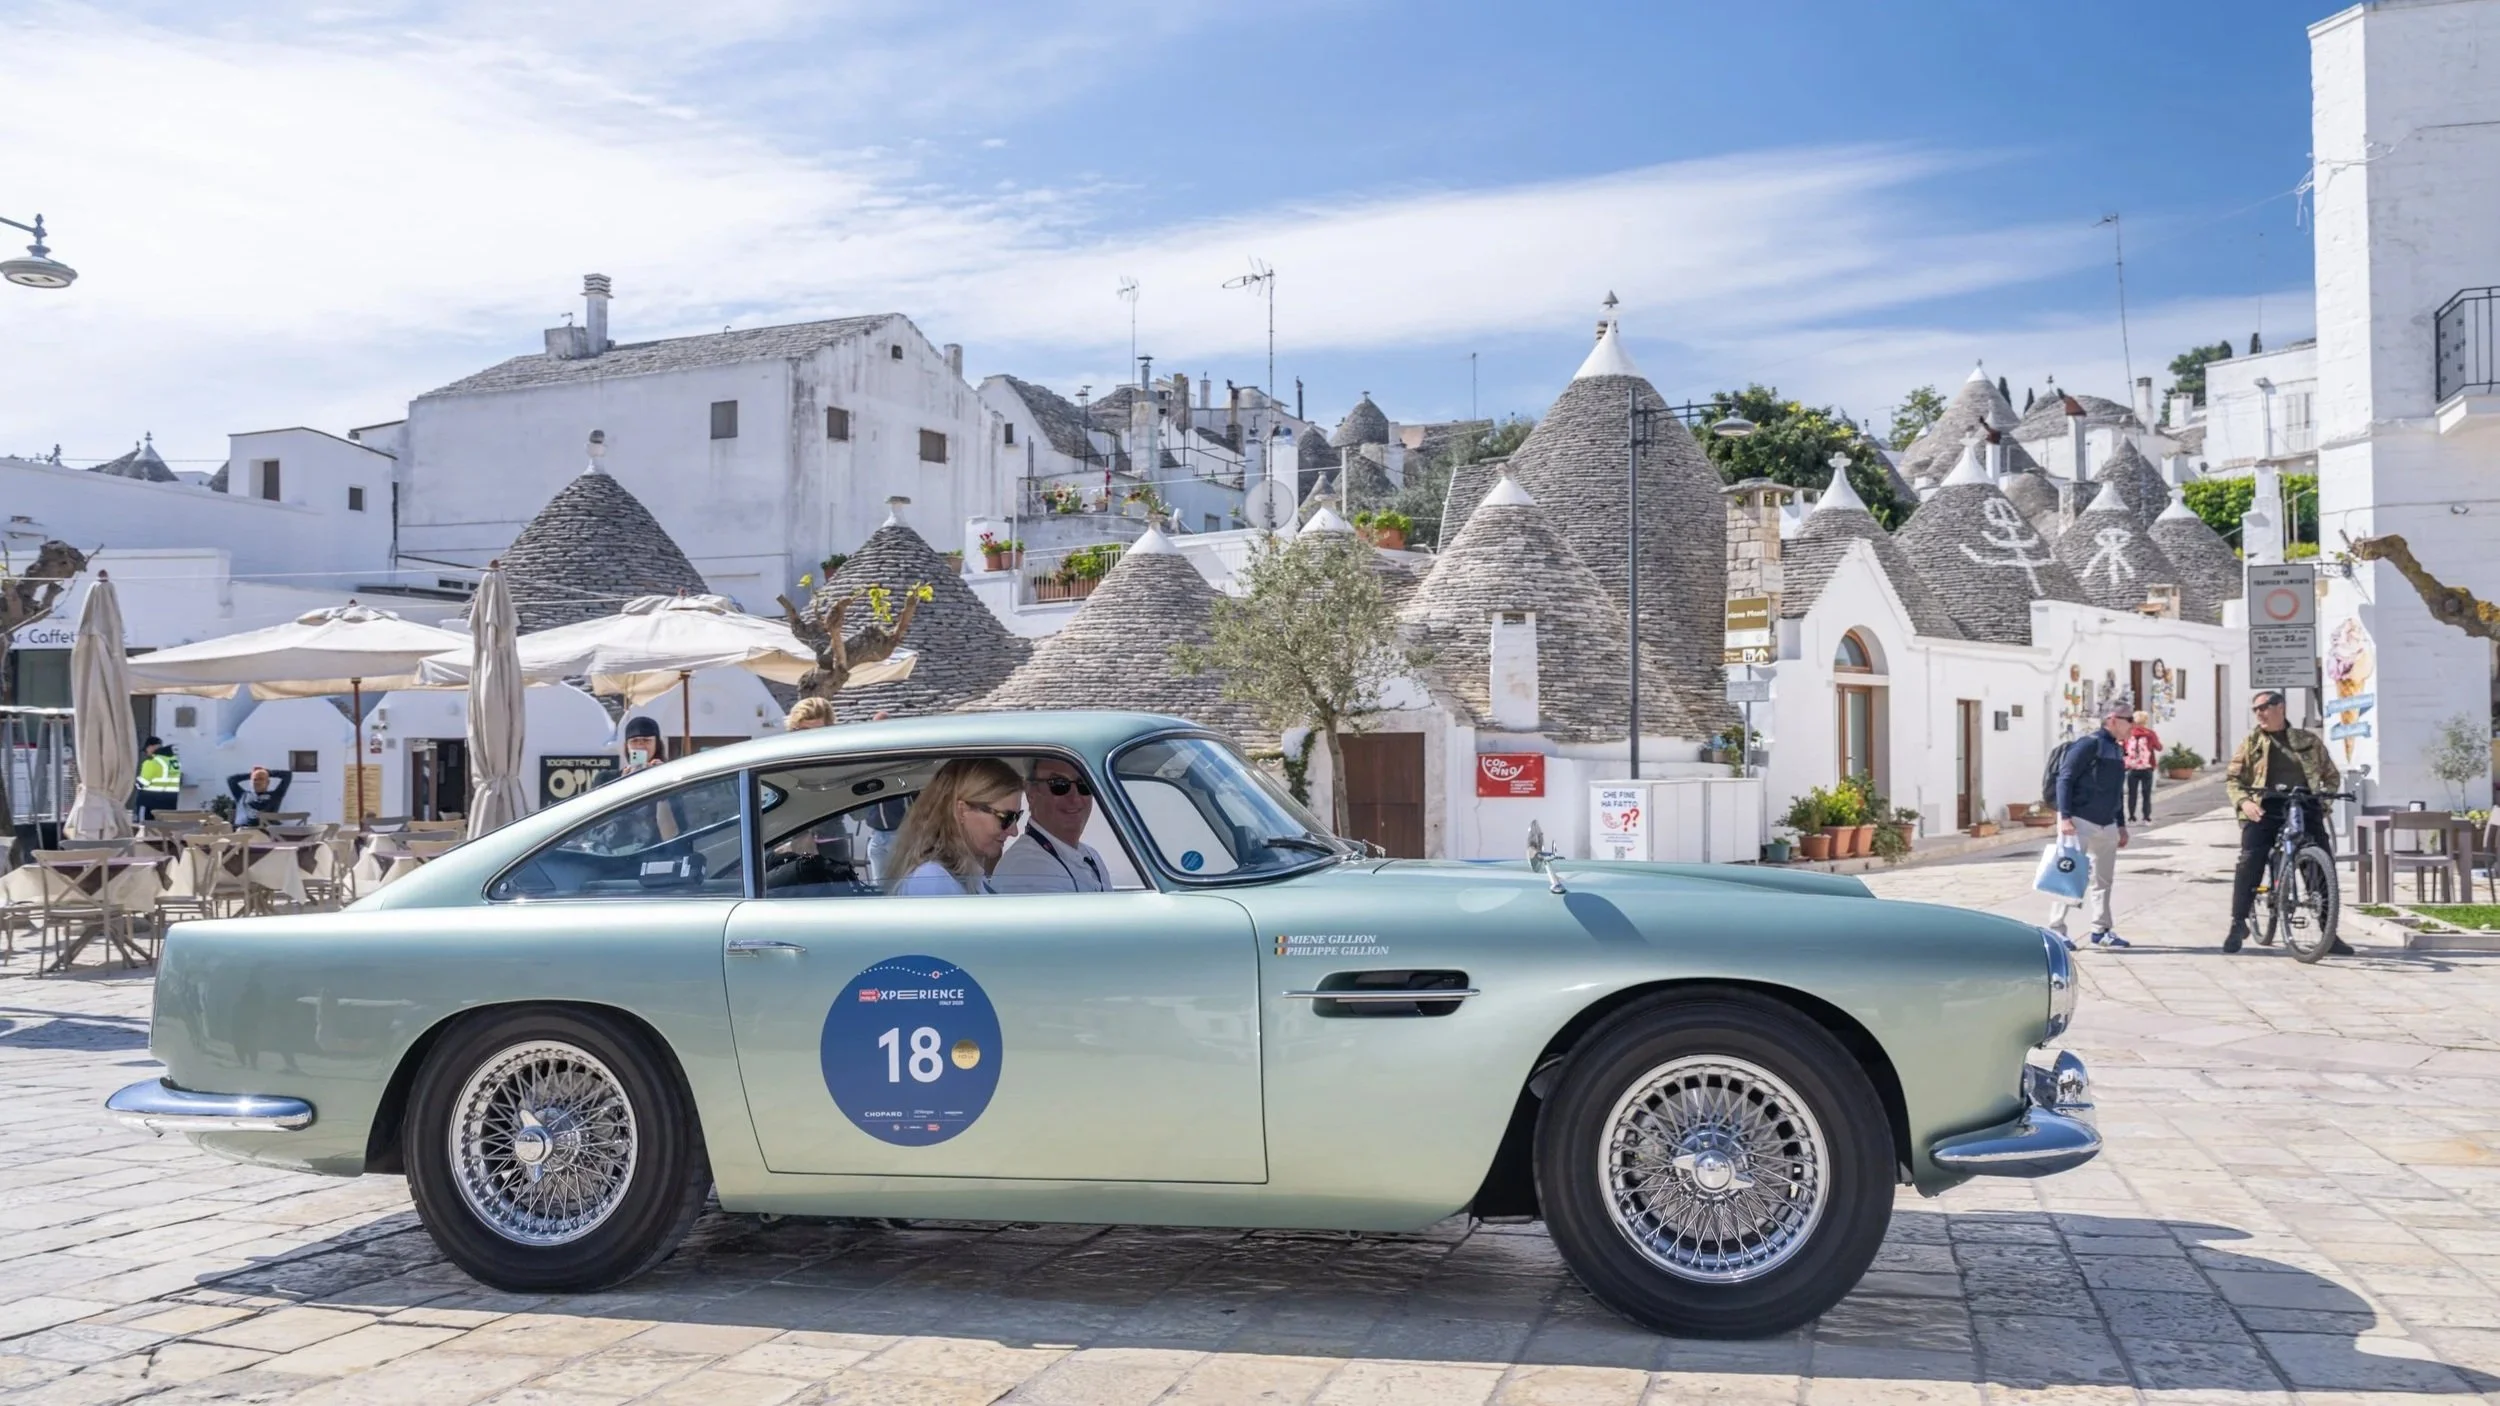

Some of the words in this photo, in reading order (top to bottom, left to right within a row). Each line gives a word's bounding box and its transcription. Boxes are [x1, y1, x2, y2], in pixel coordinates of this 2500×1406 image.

[29, 629, 75, 643] Caffet
[1328, 935, 1376, 944] GILLION
[1286, 946, 1338, 956] PHILIPPE
[1341, 946, 1389, 956] GILLION
[878, 1026, 944, 1083] 18
